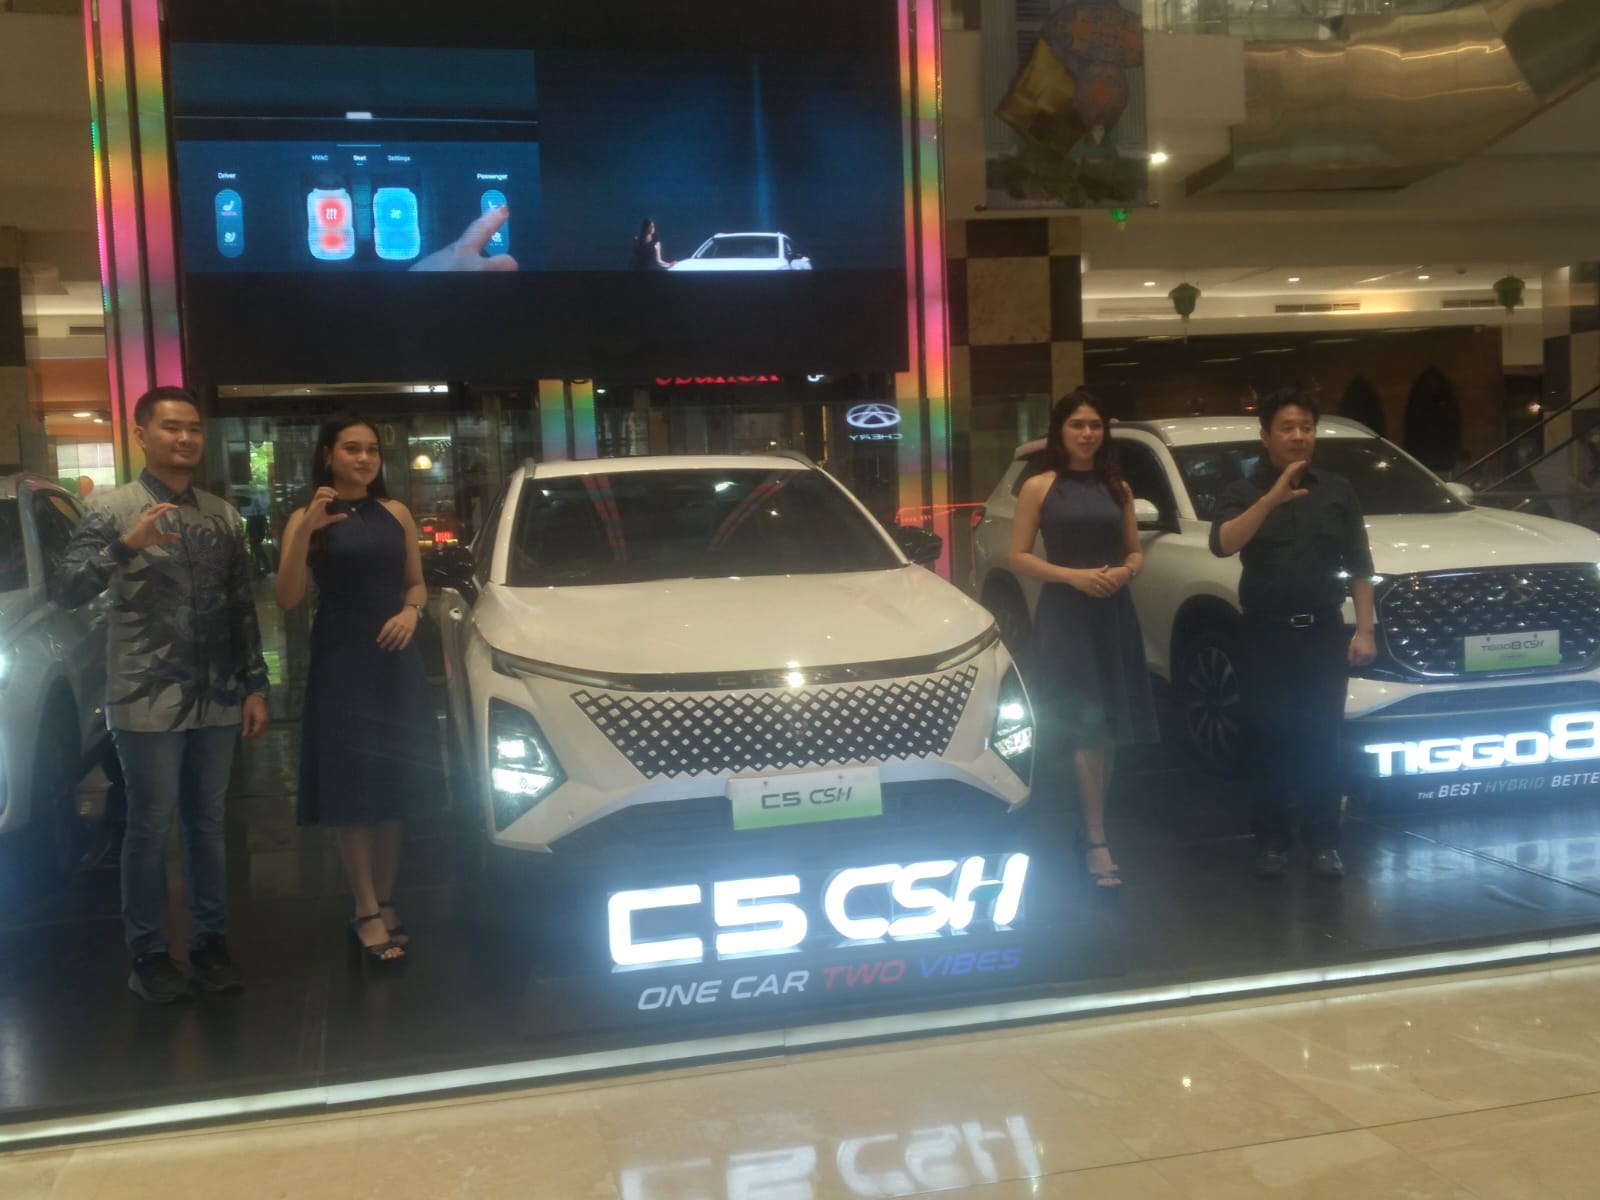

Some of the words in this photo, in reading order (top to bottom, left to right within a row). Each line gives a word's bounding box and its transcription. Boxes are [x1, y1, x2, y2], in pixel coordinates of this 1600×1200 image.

[217, 172, 237, 180] Driver
[476, 172, 508, 181] Passenger
[1364, 711, 1600, 777] TIGGO8
[761, 791, 802, 810] C5
[809, 785, 852, 805] CSH
[1416, 791, 1435, 800] THE
[1437, 782, 1482, 798] BEST
[1484, 776, 1546, 794] HYBRID
[607, 873, 808, 970] C5
[823, 852, 1030, 944] CSH
[637, 979, 723, 1010] ONE
[730, 969, 810, 1000] CAR
[823, 959, 907, 992] TWO
[918, 947, 1025, 980] VIBES
